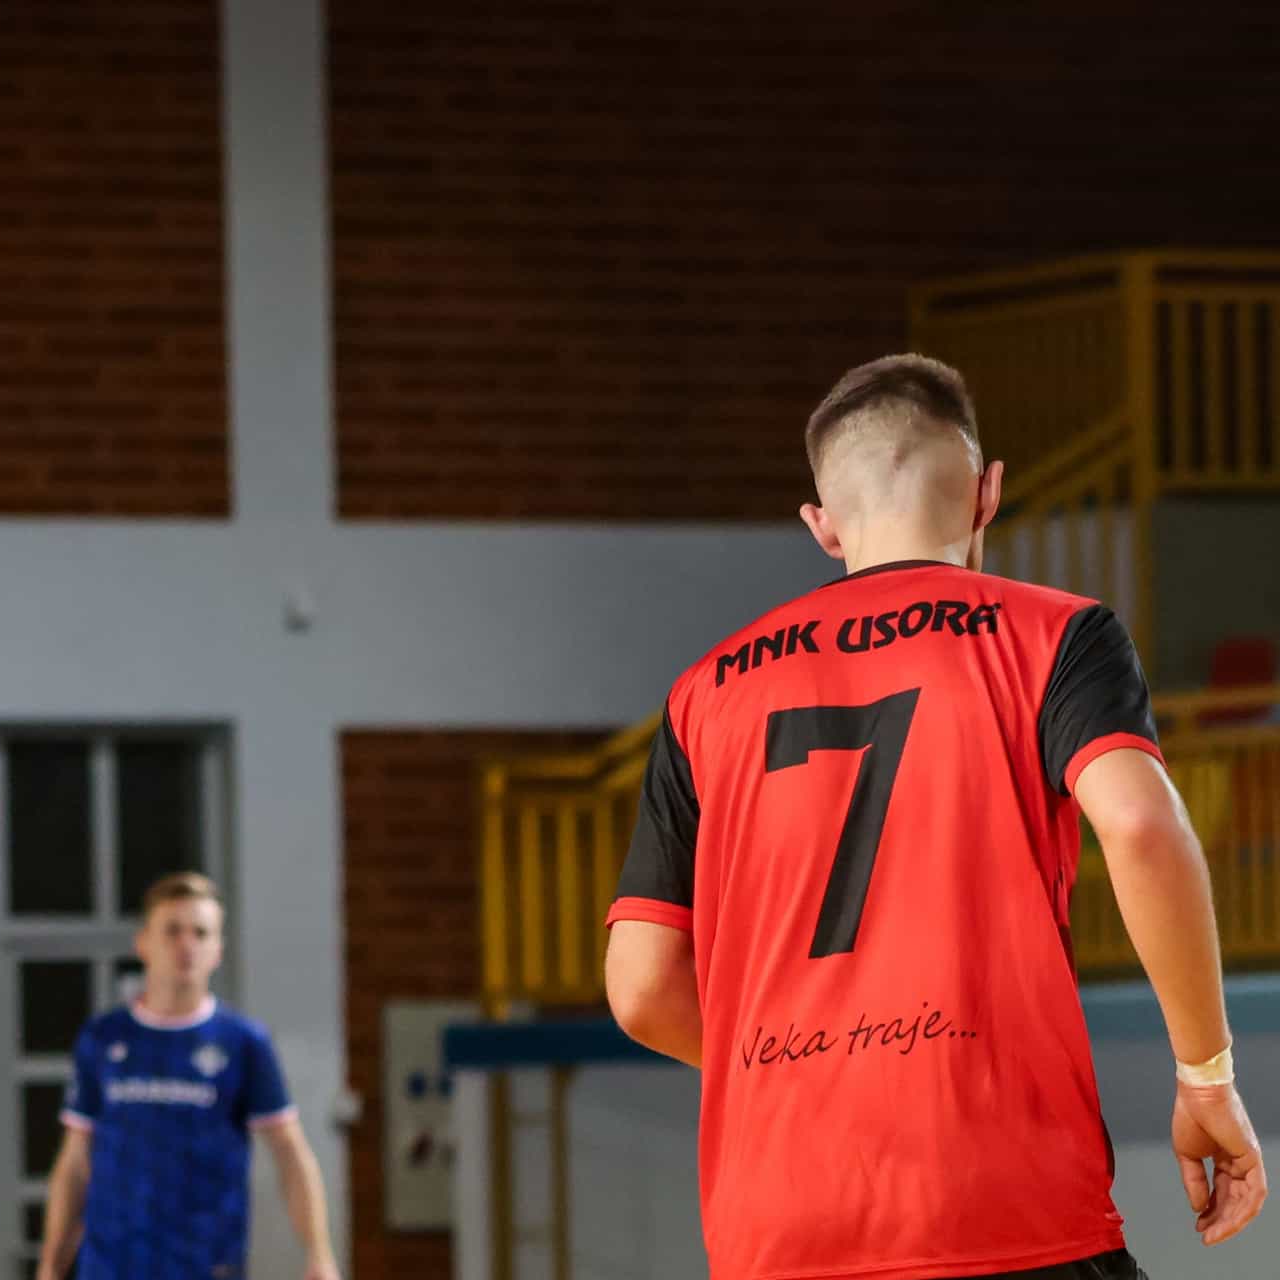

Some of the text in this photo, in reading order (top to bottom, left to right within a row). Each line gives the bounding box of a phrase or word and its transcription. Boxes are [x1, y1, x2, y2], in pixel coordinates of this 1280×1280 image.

[715, 600, 1001, 688] MNK USORA
[765, 687, 922, 960] 7
[742, 1001, 977, 1070] Veka traje...
